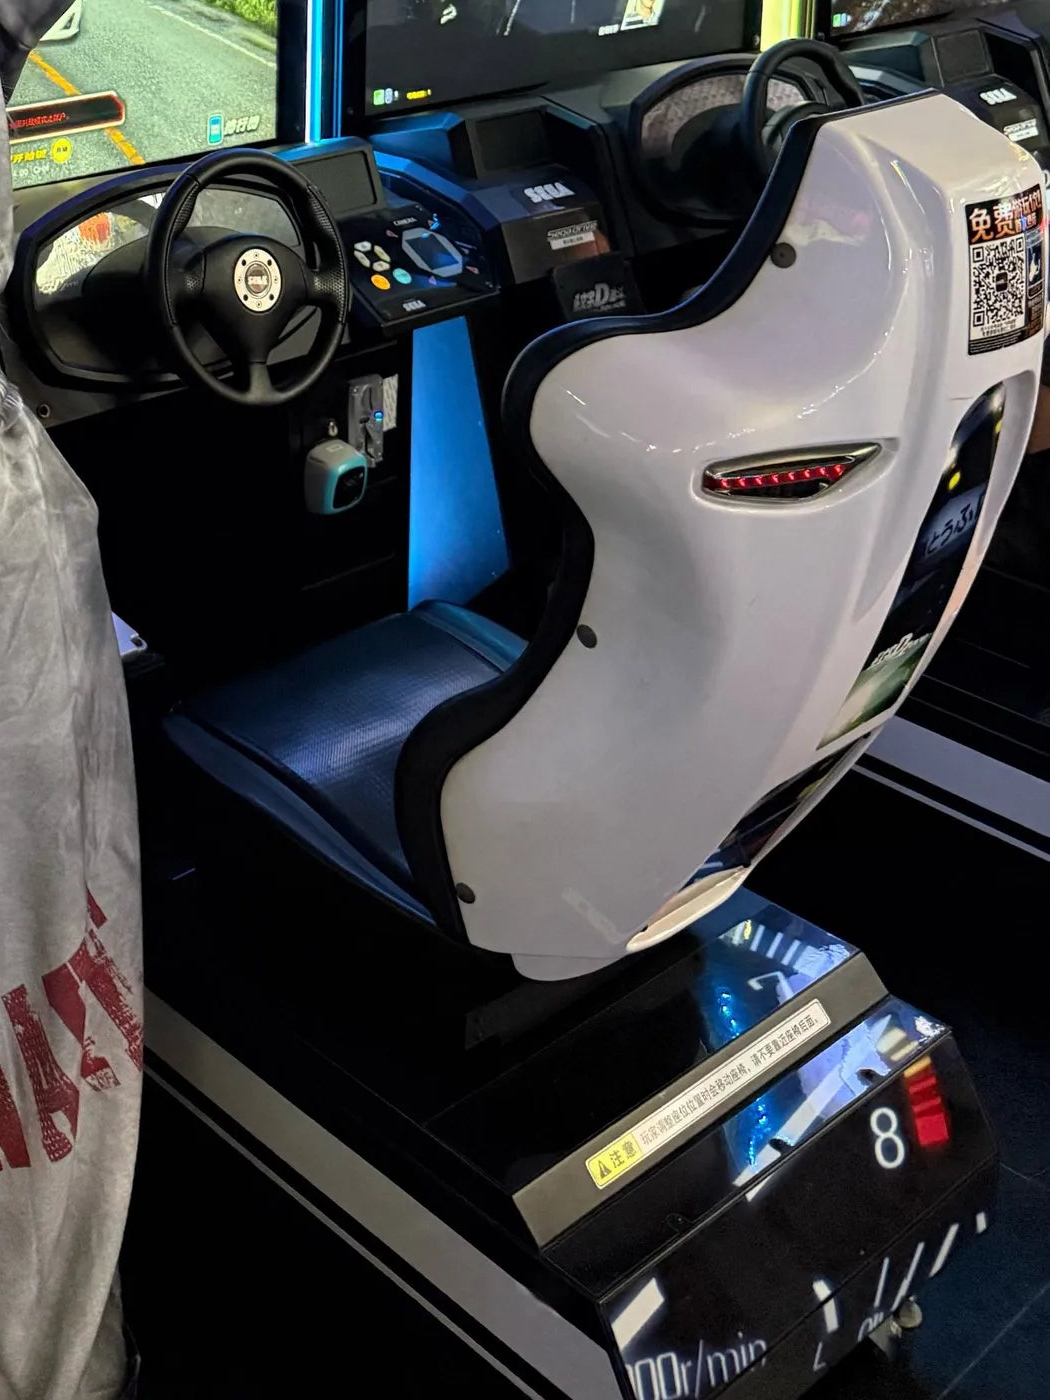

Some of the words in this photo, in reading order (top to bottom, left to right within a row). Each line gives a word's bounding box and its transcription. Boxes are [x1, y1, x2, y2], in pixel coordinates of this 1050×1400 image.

[523, 181, 576, 204] SEGA
[969, 202, 1016, 242] 免费
[608, 1138, 638, 1170] 注意
[868, 1105, 906, 1170] 8
